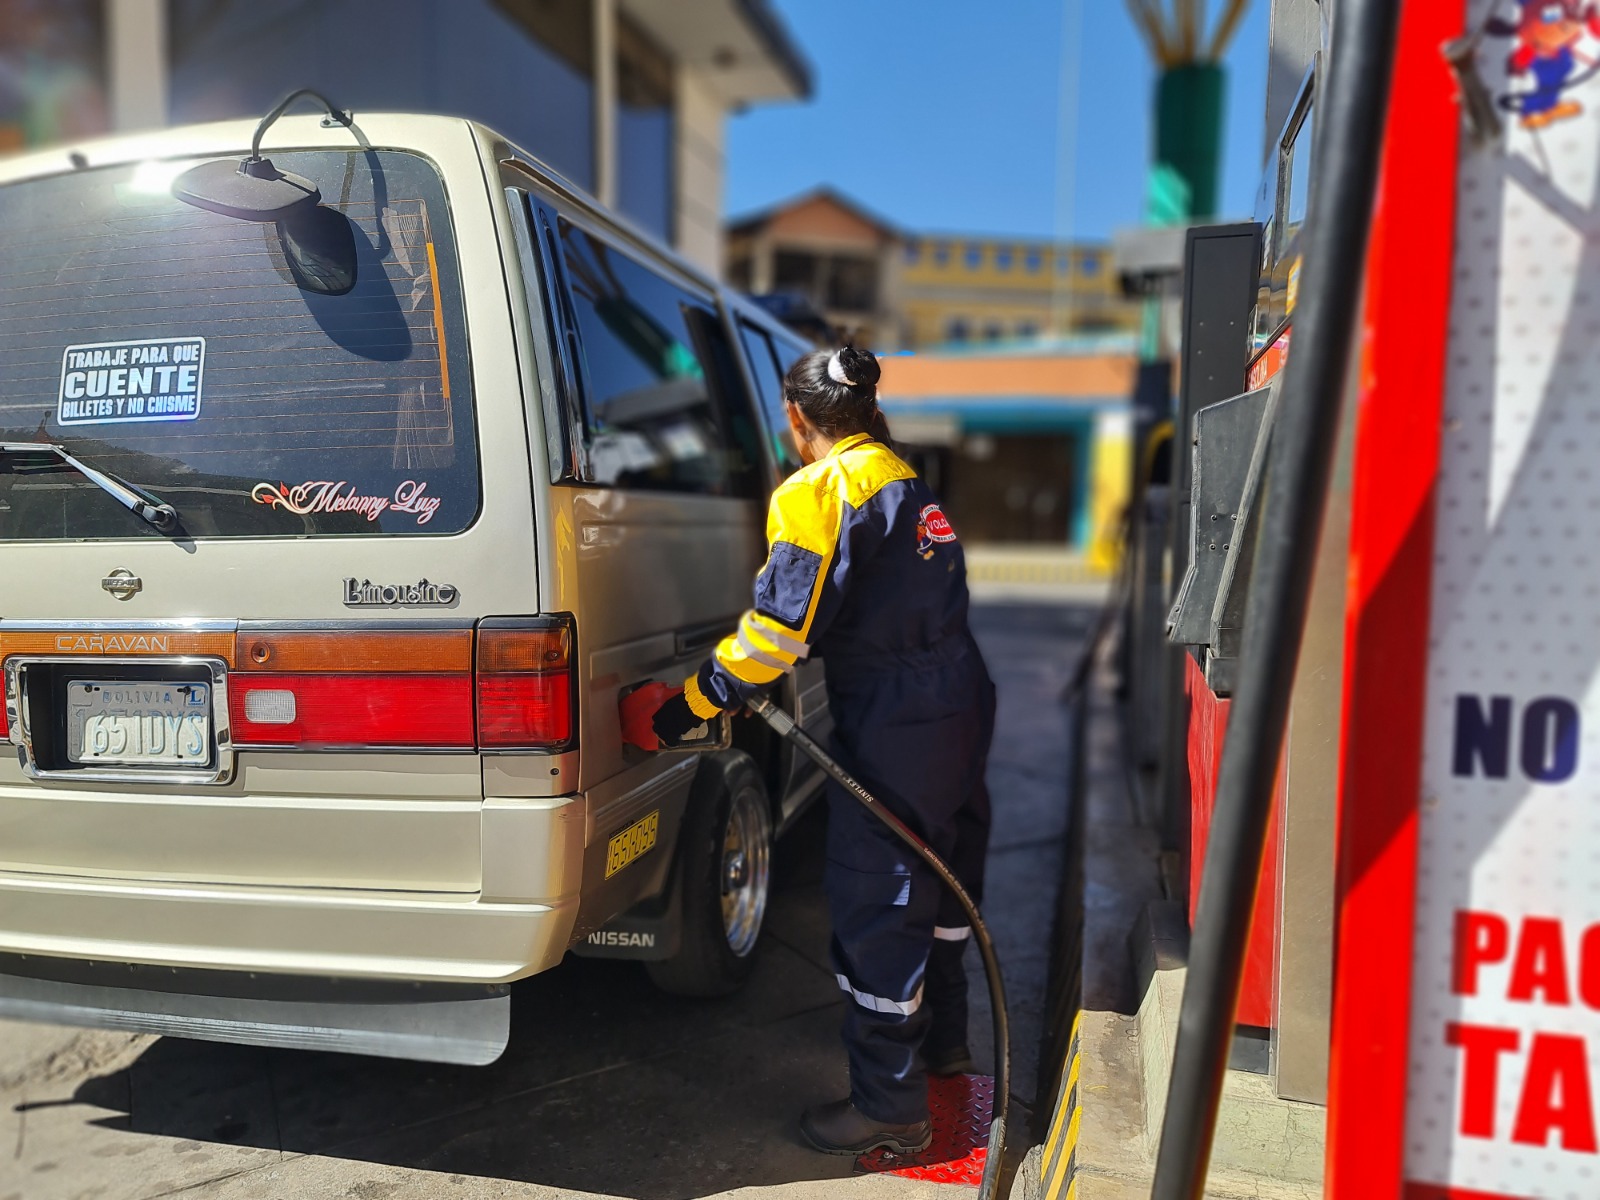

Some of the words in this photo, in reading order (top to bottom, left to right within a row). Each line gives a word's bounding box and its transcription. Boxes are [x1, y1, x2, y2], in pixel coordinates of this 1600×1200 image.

[68, 349, 128, 369] TRABAJE
[131, 346, 169, 365] PARA
[173, 344, 200, 363] QUE
[64, 365, 198, 399] CUENTE
[62, 399, 113, 418] BILLETES
[117, 398, 125, 415] Y
[127, 397, 145, 414] NO
[147, 395, 195, 413] CHISME
[389, 480, 441, 525] Luz
[342, 577, 457, 604] Limousine
[56, 636, 168, 651] CARAVAN
[103, 690, 173, 705] BOLIVIA
[1452, 693, 1580, 782] NO
[588, 931, 655, 947] NISSAN
[1444, 1022, 1599, 1153] TA
